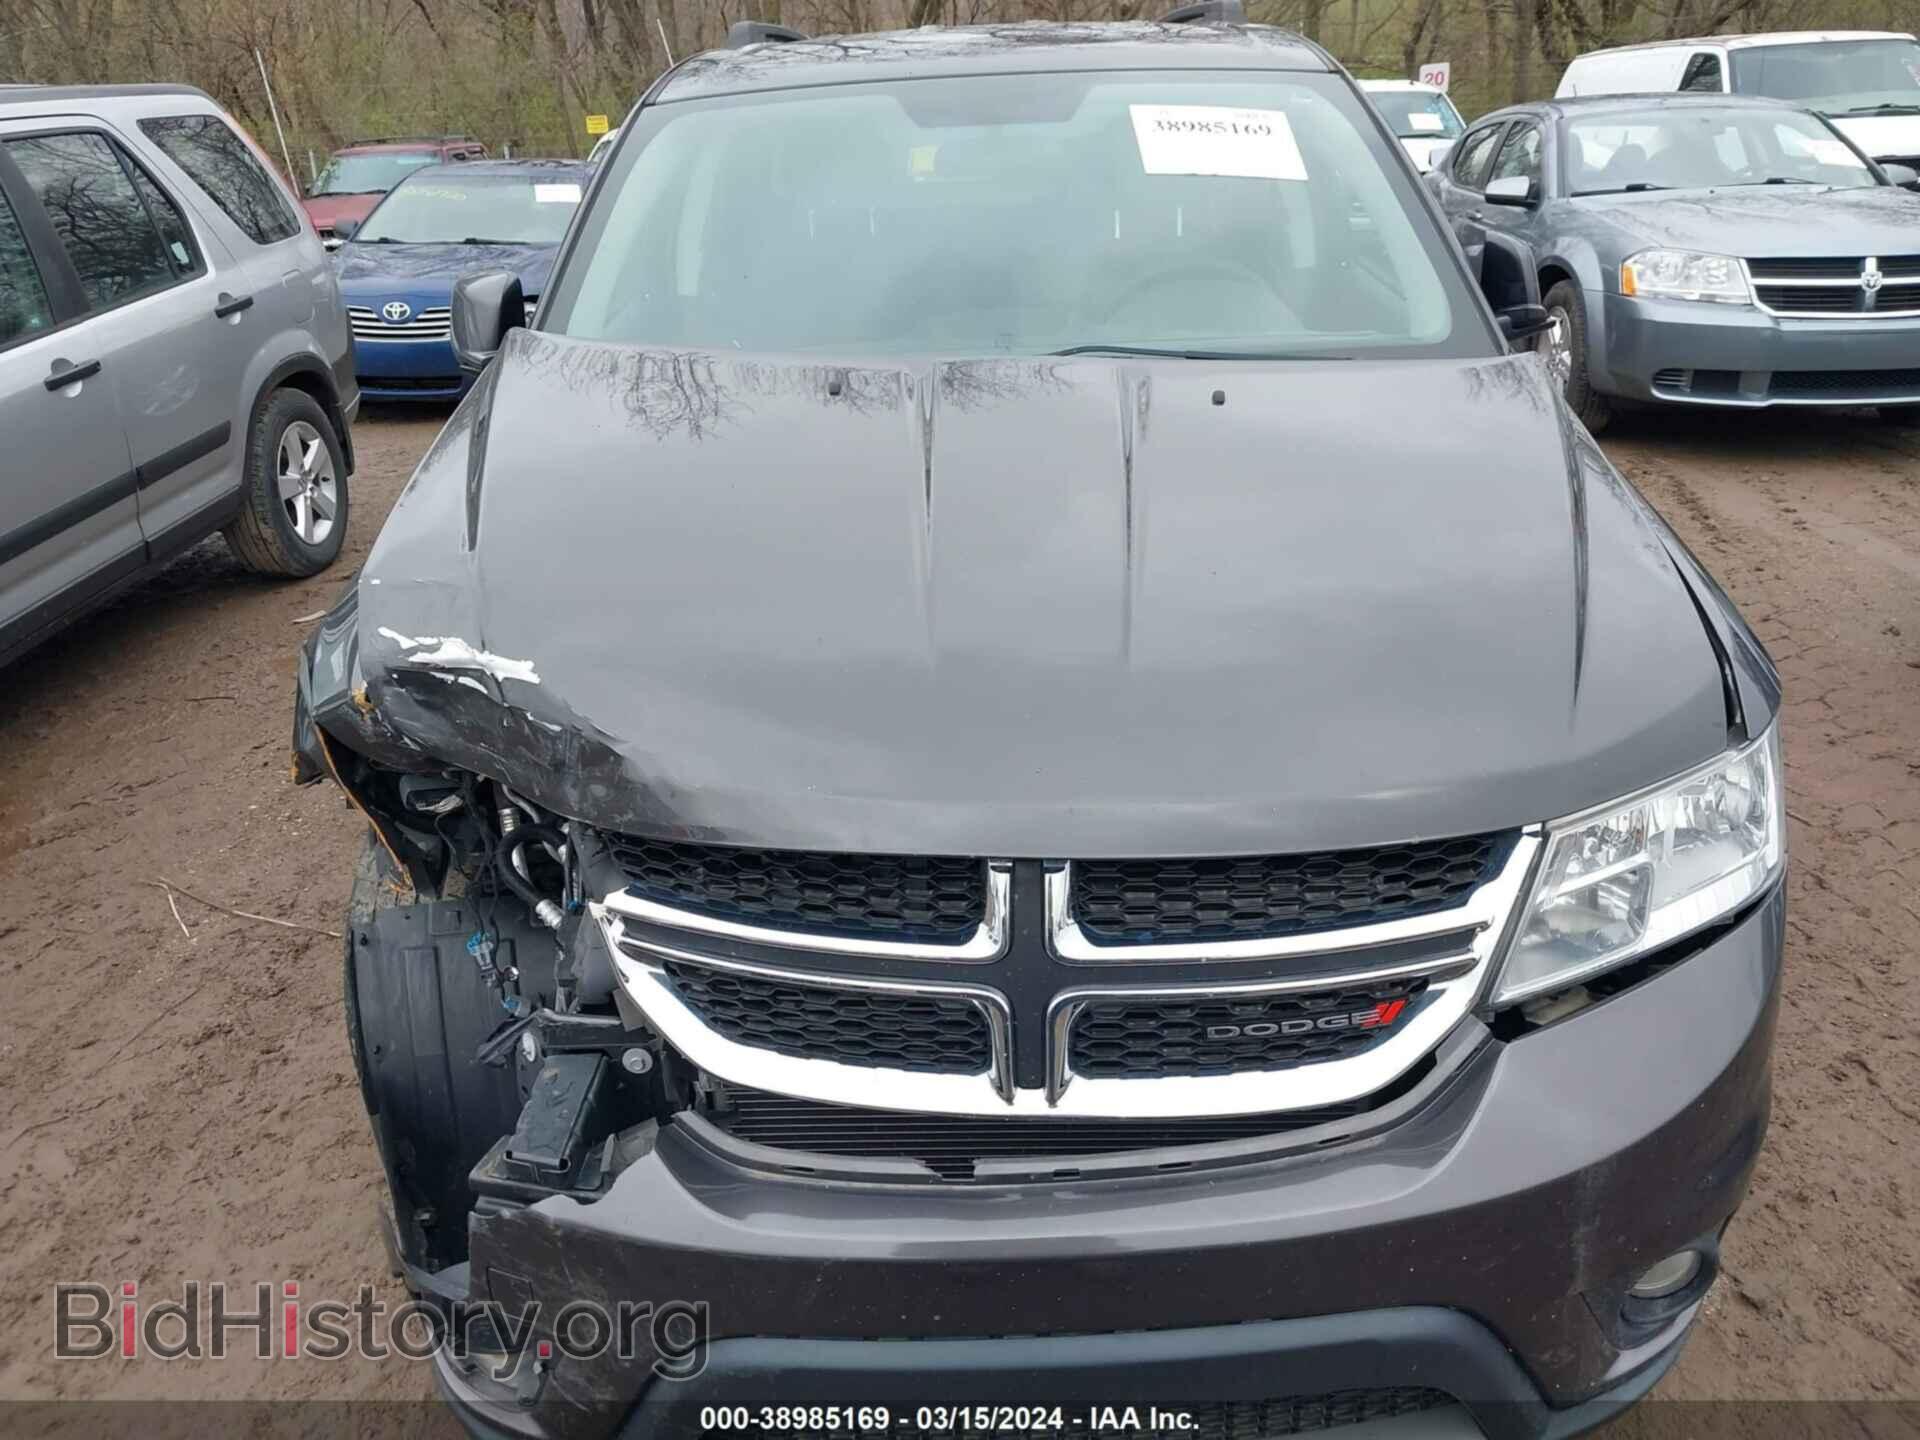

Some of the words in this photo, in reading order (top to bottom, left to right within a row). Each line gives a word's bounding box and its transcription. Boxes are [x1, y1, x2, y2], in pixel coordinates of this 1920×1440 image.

[1424, 71, 1445, 86] 20
[1152, 119, 1272, 136] 38985169
[1206, 1008, 1381, 1039] DODGE
